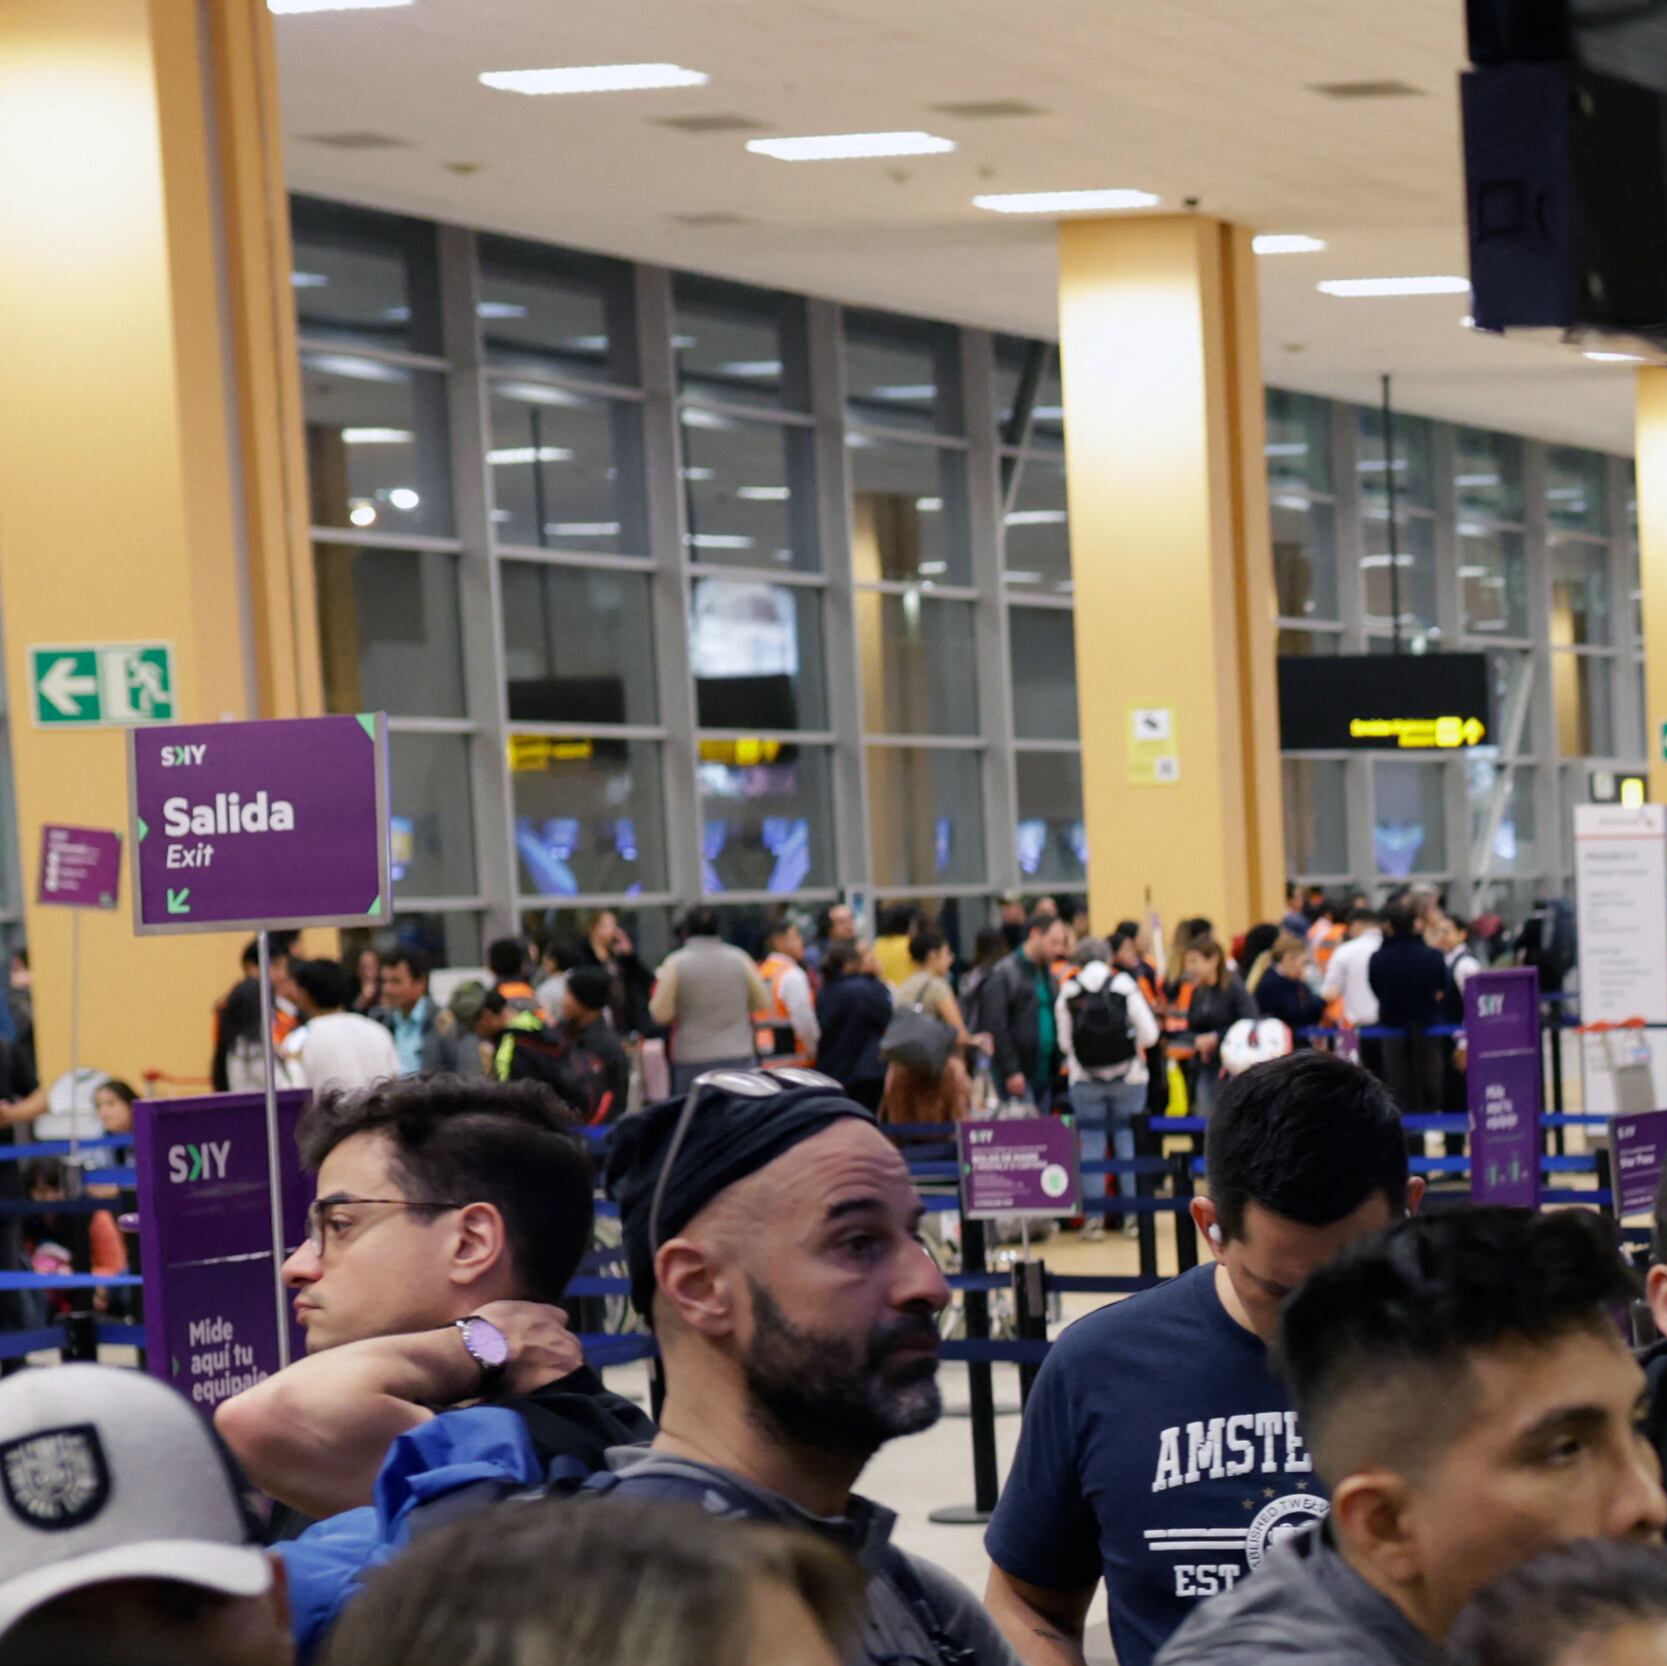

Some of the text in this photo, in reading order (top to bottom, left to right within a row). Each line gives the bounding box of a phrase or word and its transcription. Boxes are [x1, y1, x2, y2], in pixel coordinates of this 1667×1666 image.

[163, 791, 295, 838] Salida
[166, 842, 215, 870] Exit
[188, 1315, 233, 1347] Mide
[233, 1343, 253, 1367] tu
[1152, 1411, 1312, 1493] AMSTE
[1249, 1498, 1330, 1569] ABLISHED TWELV
